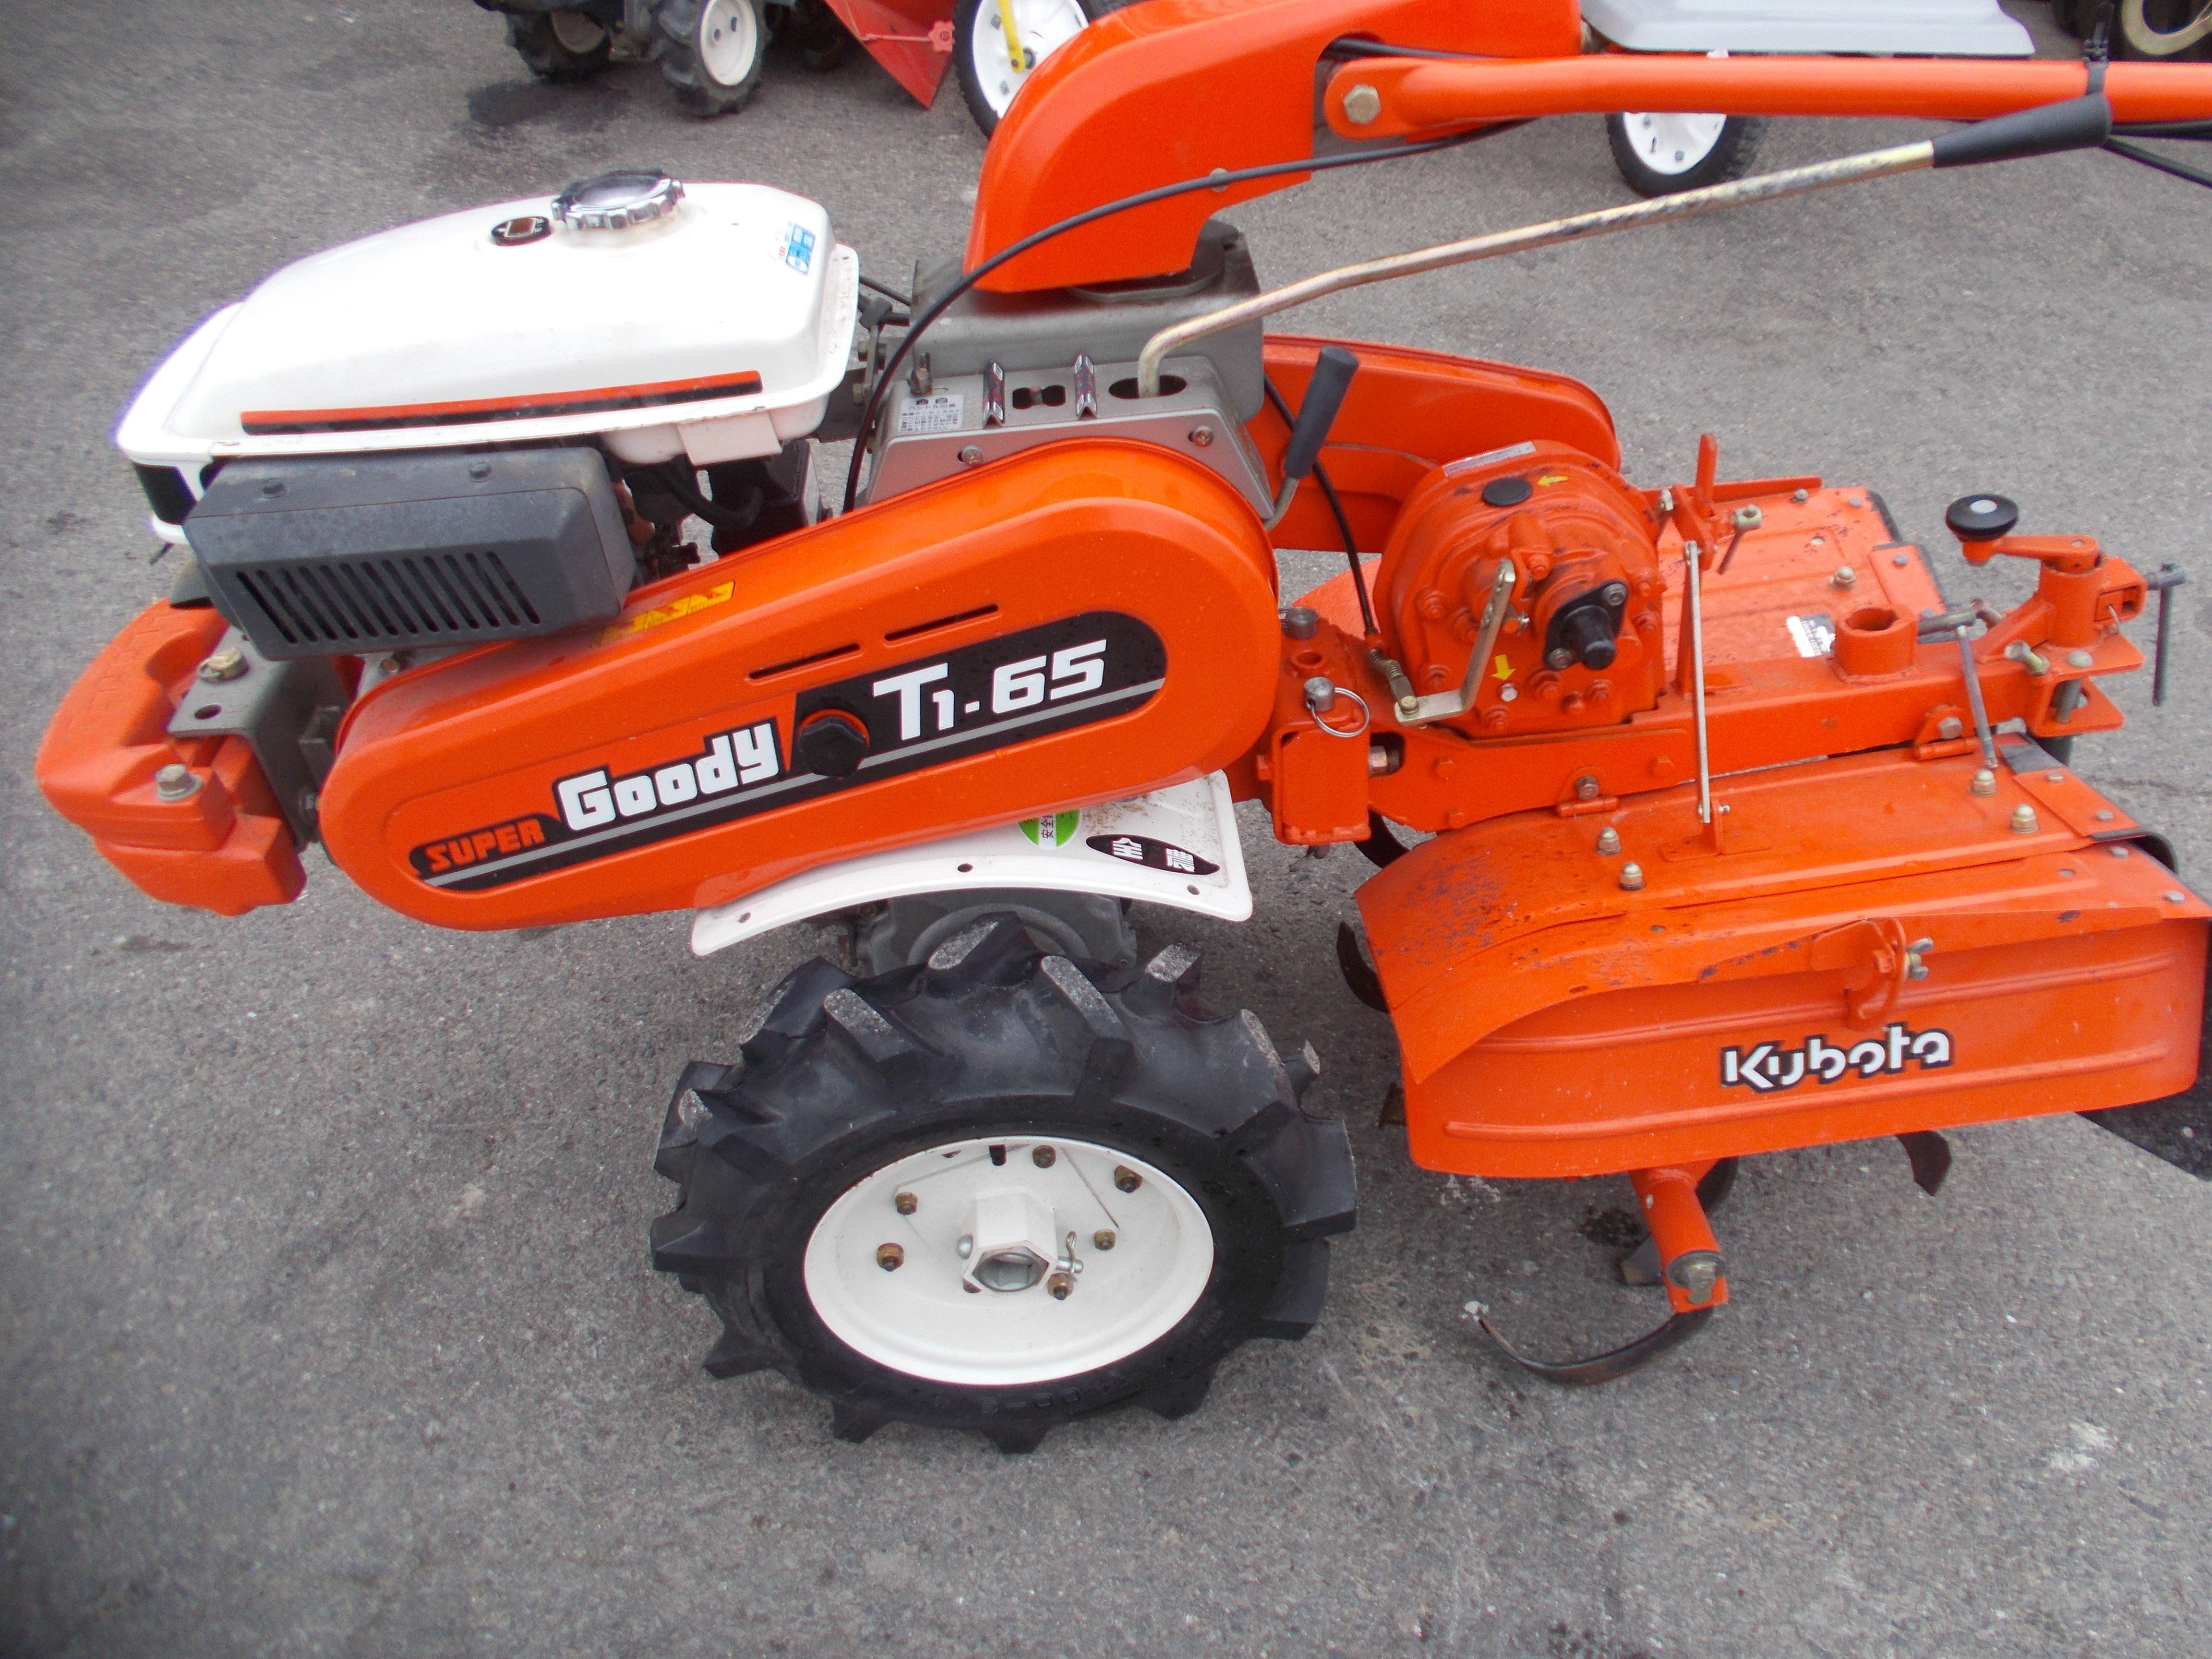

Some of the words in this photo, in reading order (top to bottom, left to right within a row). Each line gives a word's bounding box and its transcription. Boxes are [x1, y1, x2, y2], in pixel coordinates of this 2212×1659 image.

[424, 818, 545, 873] SUPER
[558, 722, 780, 830] Goody
[1113, 837, 1195, 873] 全農
[1724, 1025, 1950, 1089] Kubota
